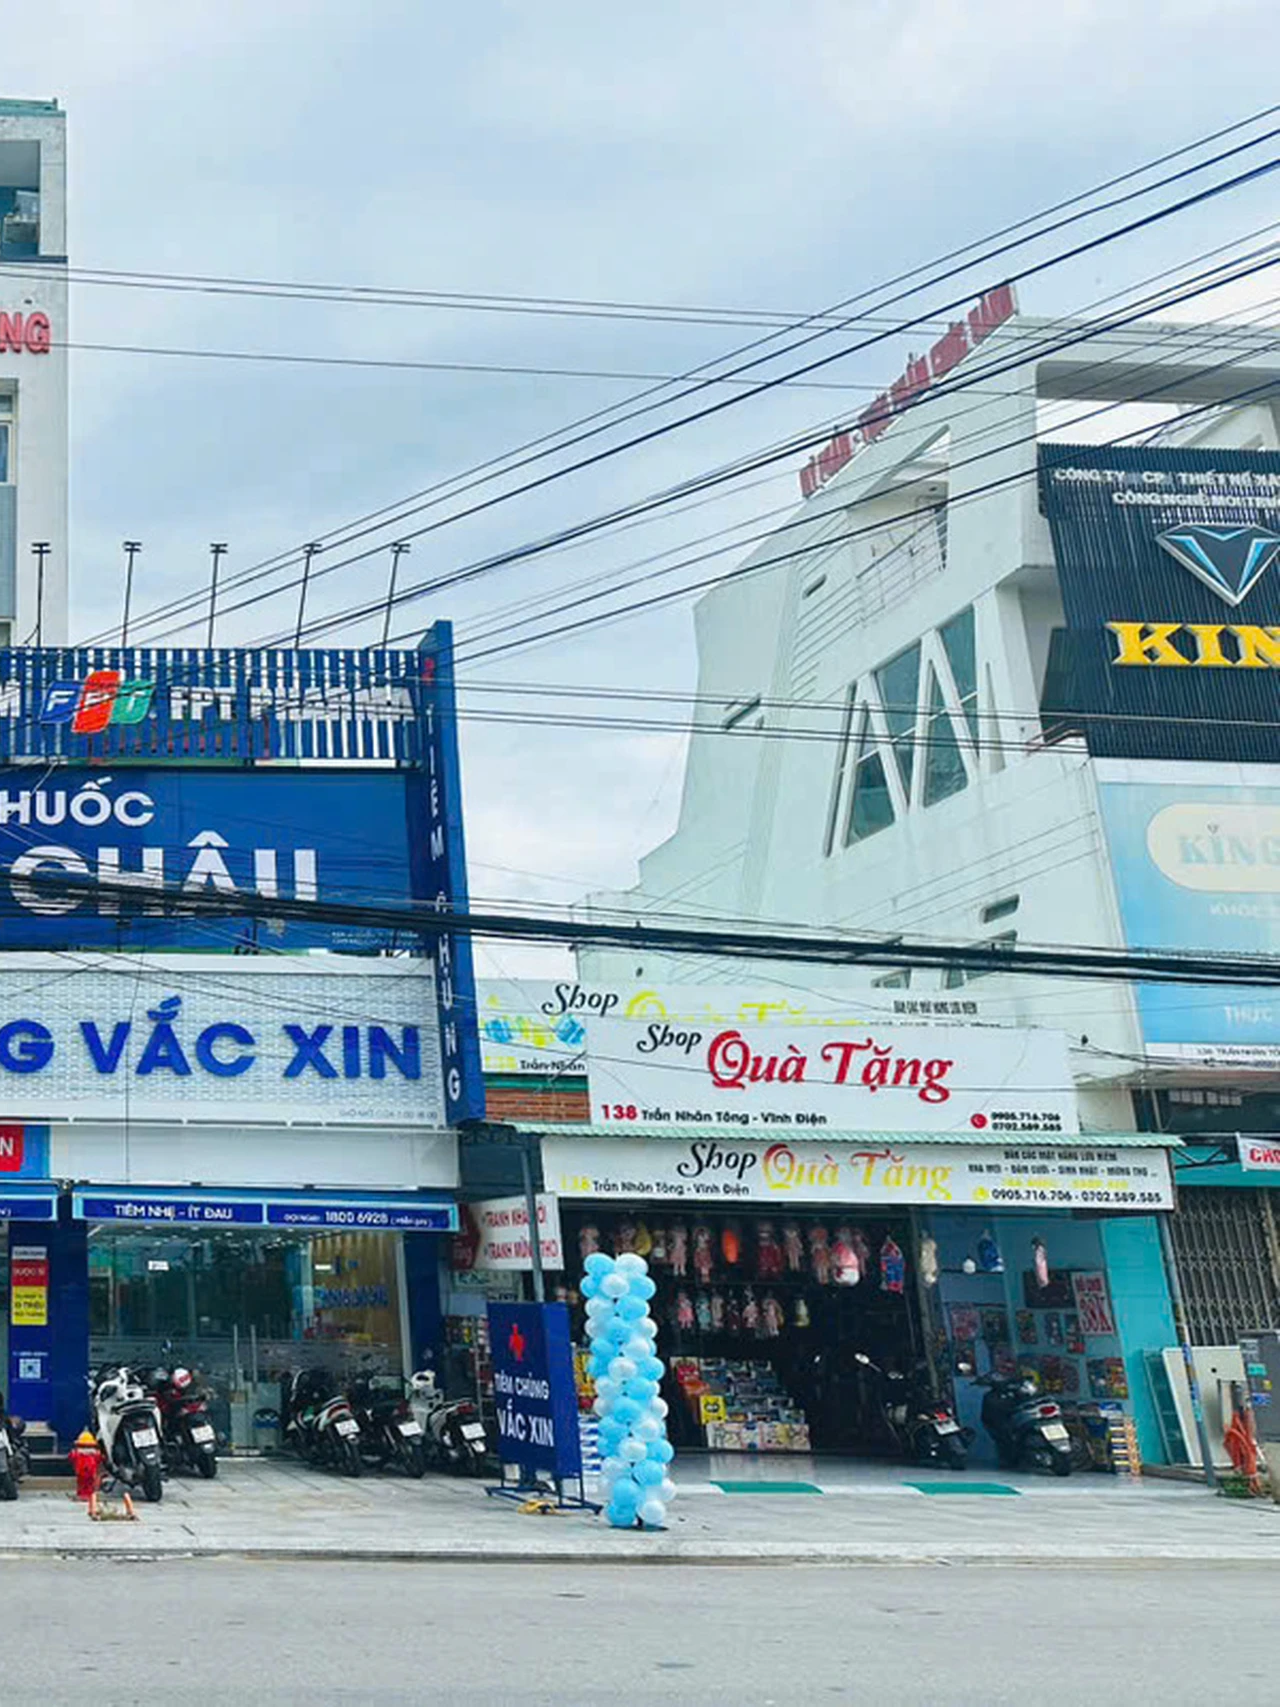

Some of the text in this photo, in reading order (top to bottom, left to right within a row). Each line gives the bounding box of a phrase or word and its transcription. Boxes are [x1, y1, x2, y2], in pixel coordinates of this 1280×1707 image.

[170, 686, 233, 720] FPT
[10, 830, 318, 917] CHÂU
[541, 983, 620, 1017] Shop
[80, 995, 257, 1078] VẮC
[283, 1023, 421, 1080] XIN
[637, 1023, 955, 1104] Shop Quà Tặng
[601, 1105, 638, 1121] 138
[641, 1108, 671, 1122] Trần
[676, 1109, 712, 1123] Nhân
[715, 1110, 750, 1125] Tông
[761, 1110, 792, 1124] Vĩnh
[795, 1111, 828, 1126] Điện
[677, 1142, 757, 1178] Shop
[762, 1143, 840, 1190] Quà
[991, 1188, 1073, 1201] 0905.716.706
[1082, 1190, 1162, 1203] 0702.589.585
[204, 1206, 233, 1220] ĐAU
[325, 1211, 355, 1224] 1800
[357, 1212, 388, 1225] 6928
[515, 1371, 550, 1400] CHỦNG
[496, 1399, 555, 1448] VẮC XIN
